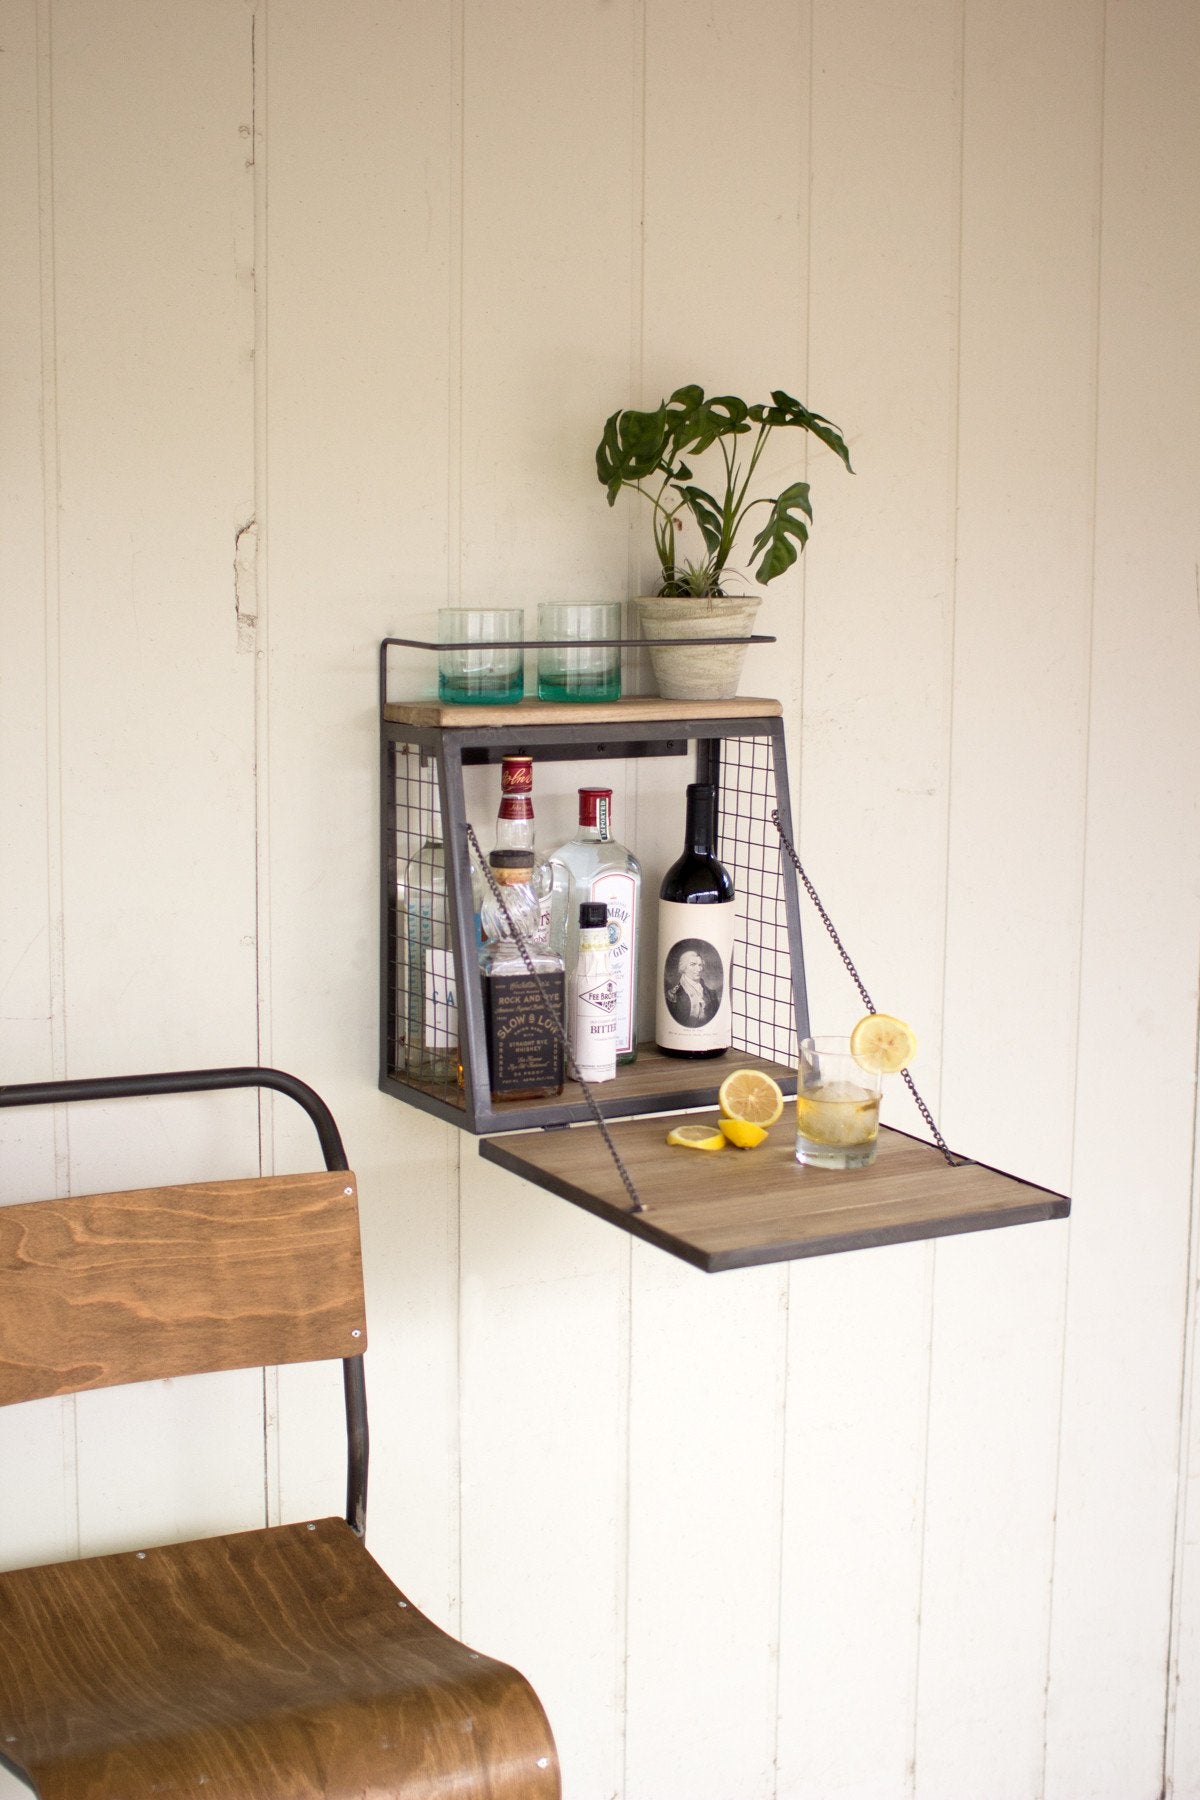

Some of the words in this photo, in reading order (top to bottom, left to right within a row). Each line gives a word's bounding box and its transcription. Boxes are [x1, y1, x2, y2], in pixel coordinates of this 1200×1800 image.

[606, 907, 630, 922] MBAY
[613, 943, 628, 958] GIN
[498, 996, 520, 1005] ROCK
[523, 994, 540, 1003] AND
[588, 992, 599, 1001] FEE
[497, 1014, 526, 1039] SLOW
[538, 1015, 560, 1034] LOW
